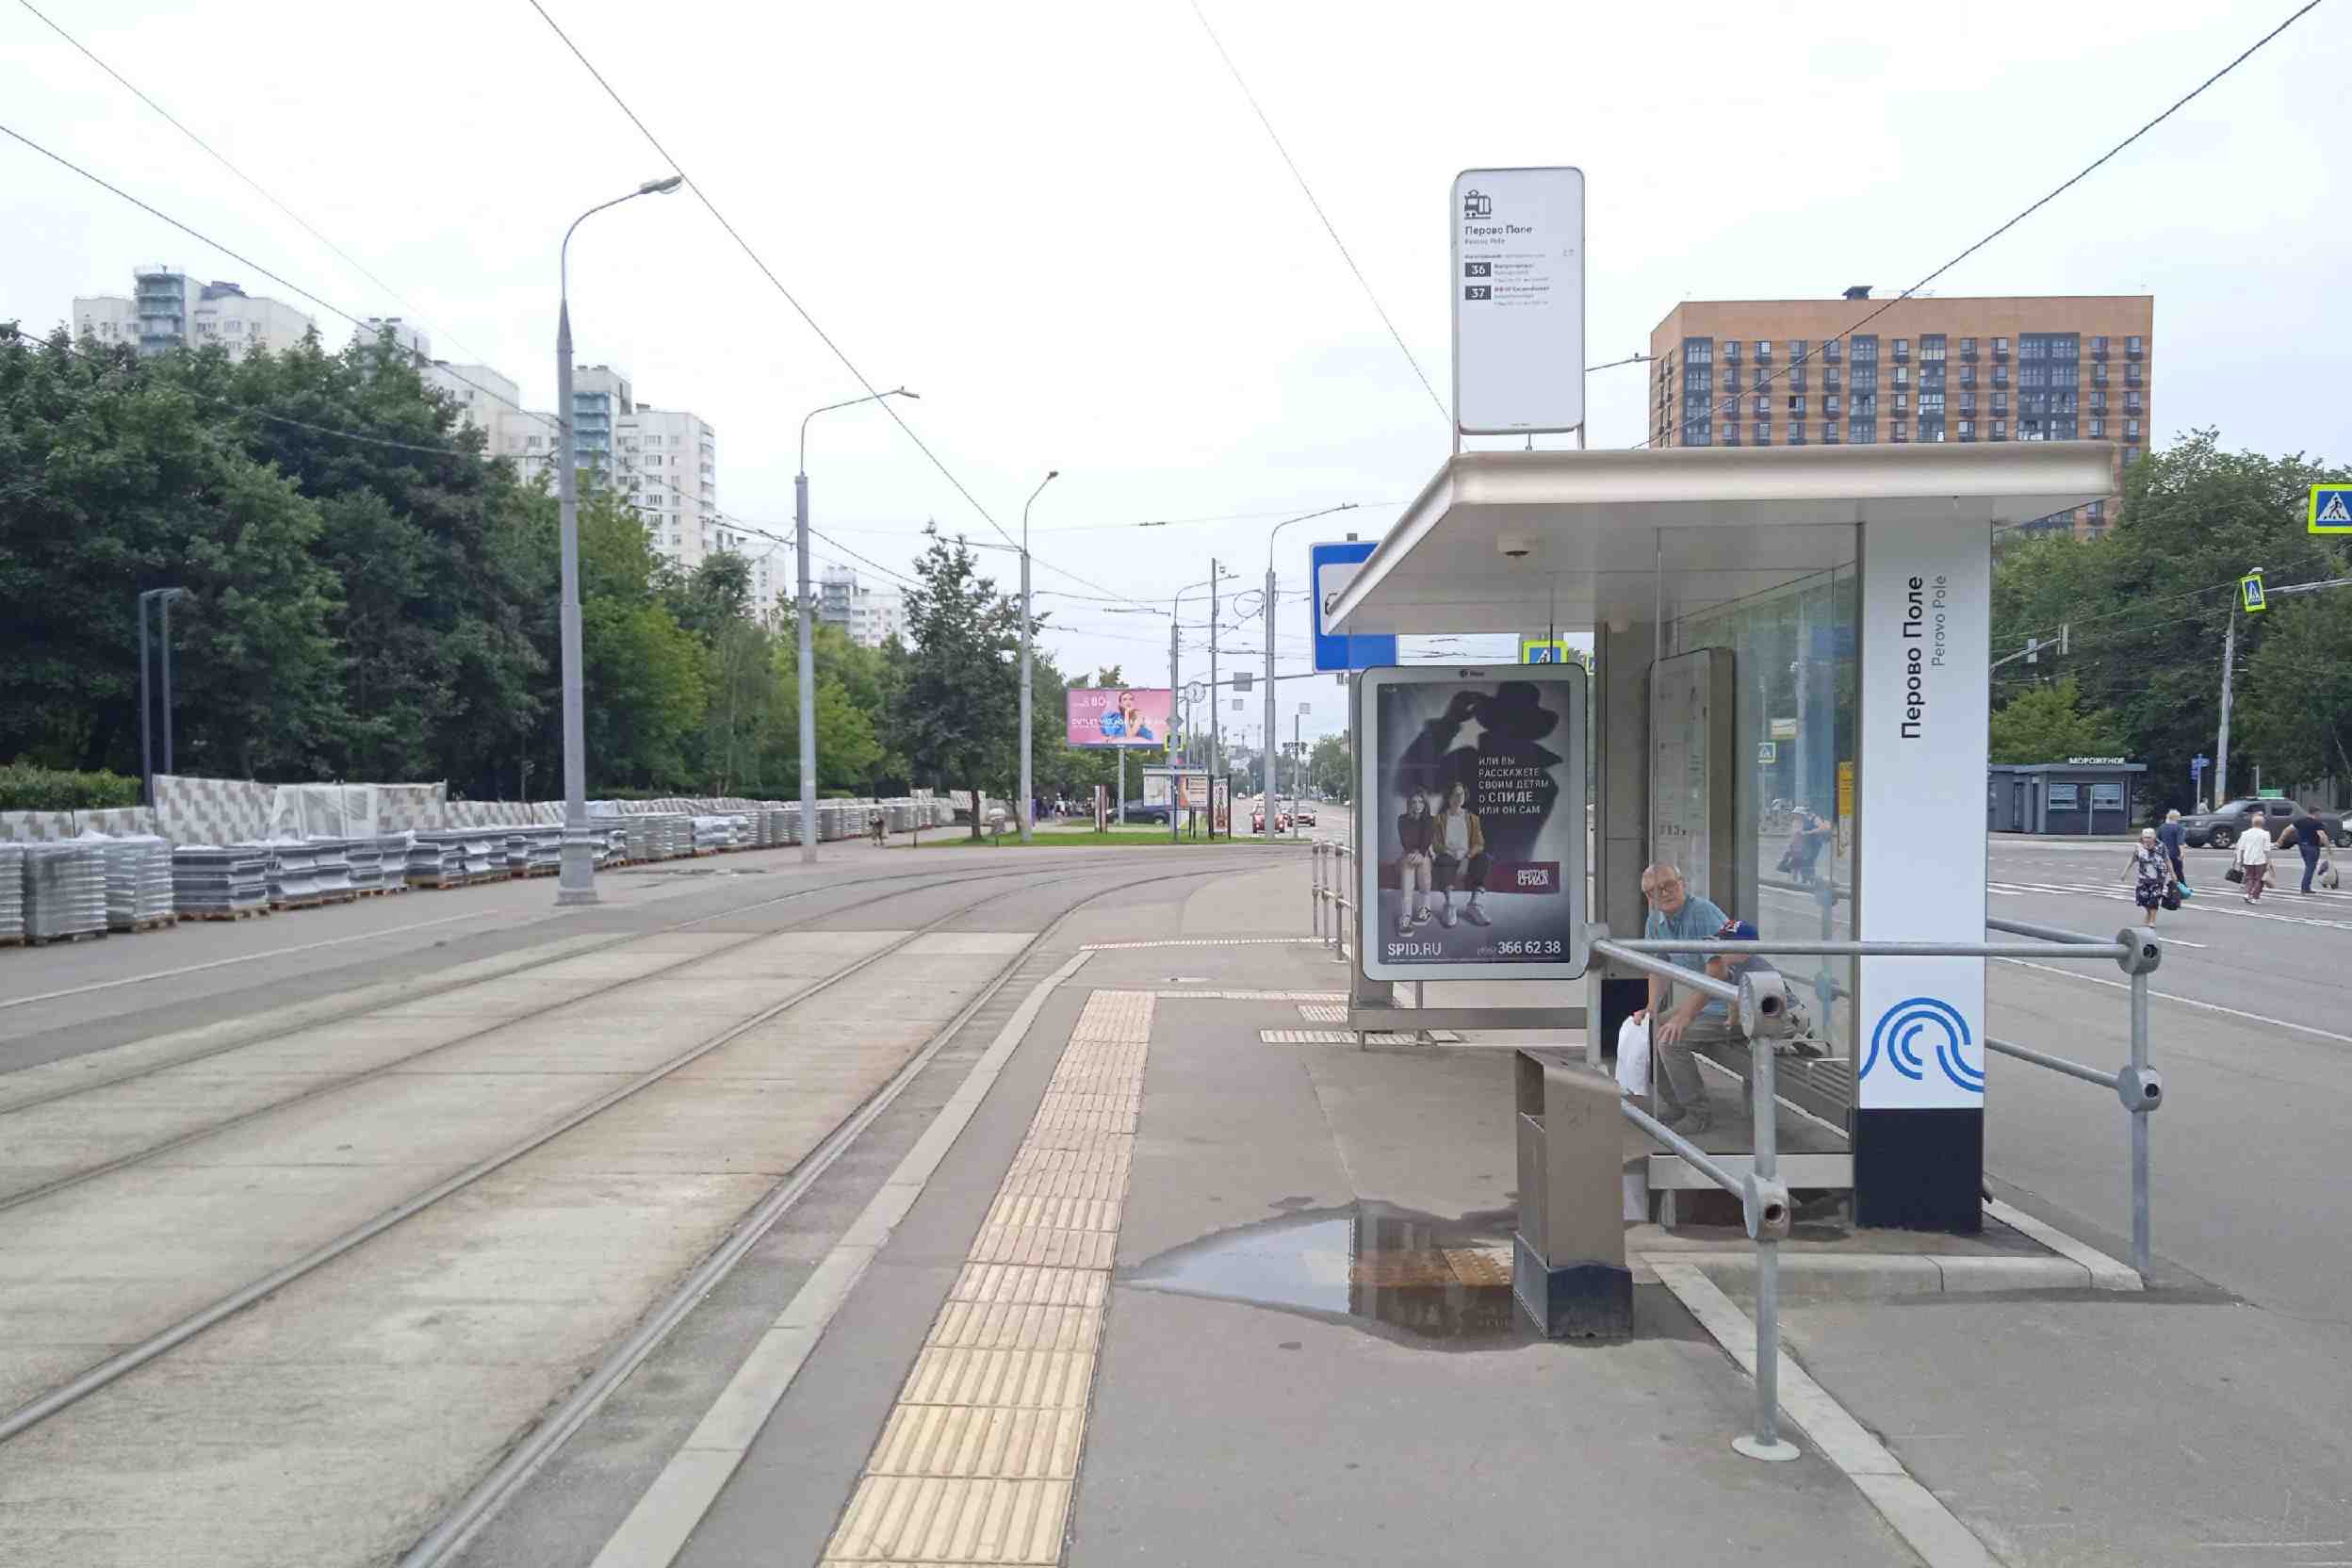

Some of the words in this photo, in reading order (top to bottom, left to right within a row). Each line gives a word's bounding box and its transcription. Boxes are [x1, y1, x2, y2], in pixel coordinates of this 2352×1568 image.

[1464, 225, 1504, 237] Перово
[1506, 224, 1532, 235] Поле
[1932, 575, 1946, 609] Pole
[1903, 576, 1923, 638] Поле
[1932, 612, 1946, 666] Perovo
[1901, 647, 1925, 739] Перово
[1478, 755, 1499, 766] ИЛИ
[1478, 768, 1539, 777] РАССКАЖЕТЕ
[1478, 779, 1513, 790] СВОИМ
[1489, 791, 1534, 803] СПИДЕ
[1478, 806, 1499, 815] ИЛИ
[1502, 806, 1516, 815] ОН
[1518, 805, 1541, 815] САМ
[1387, 941, 1443, 956] SPID.RU
[1497, 940, 1523, 955] 366
[1525, 940, 1543, 955] 62
[1544, 940, 1561, 955] 38
